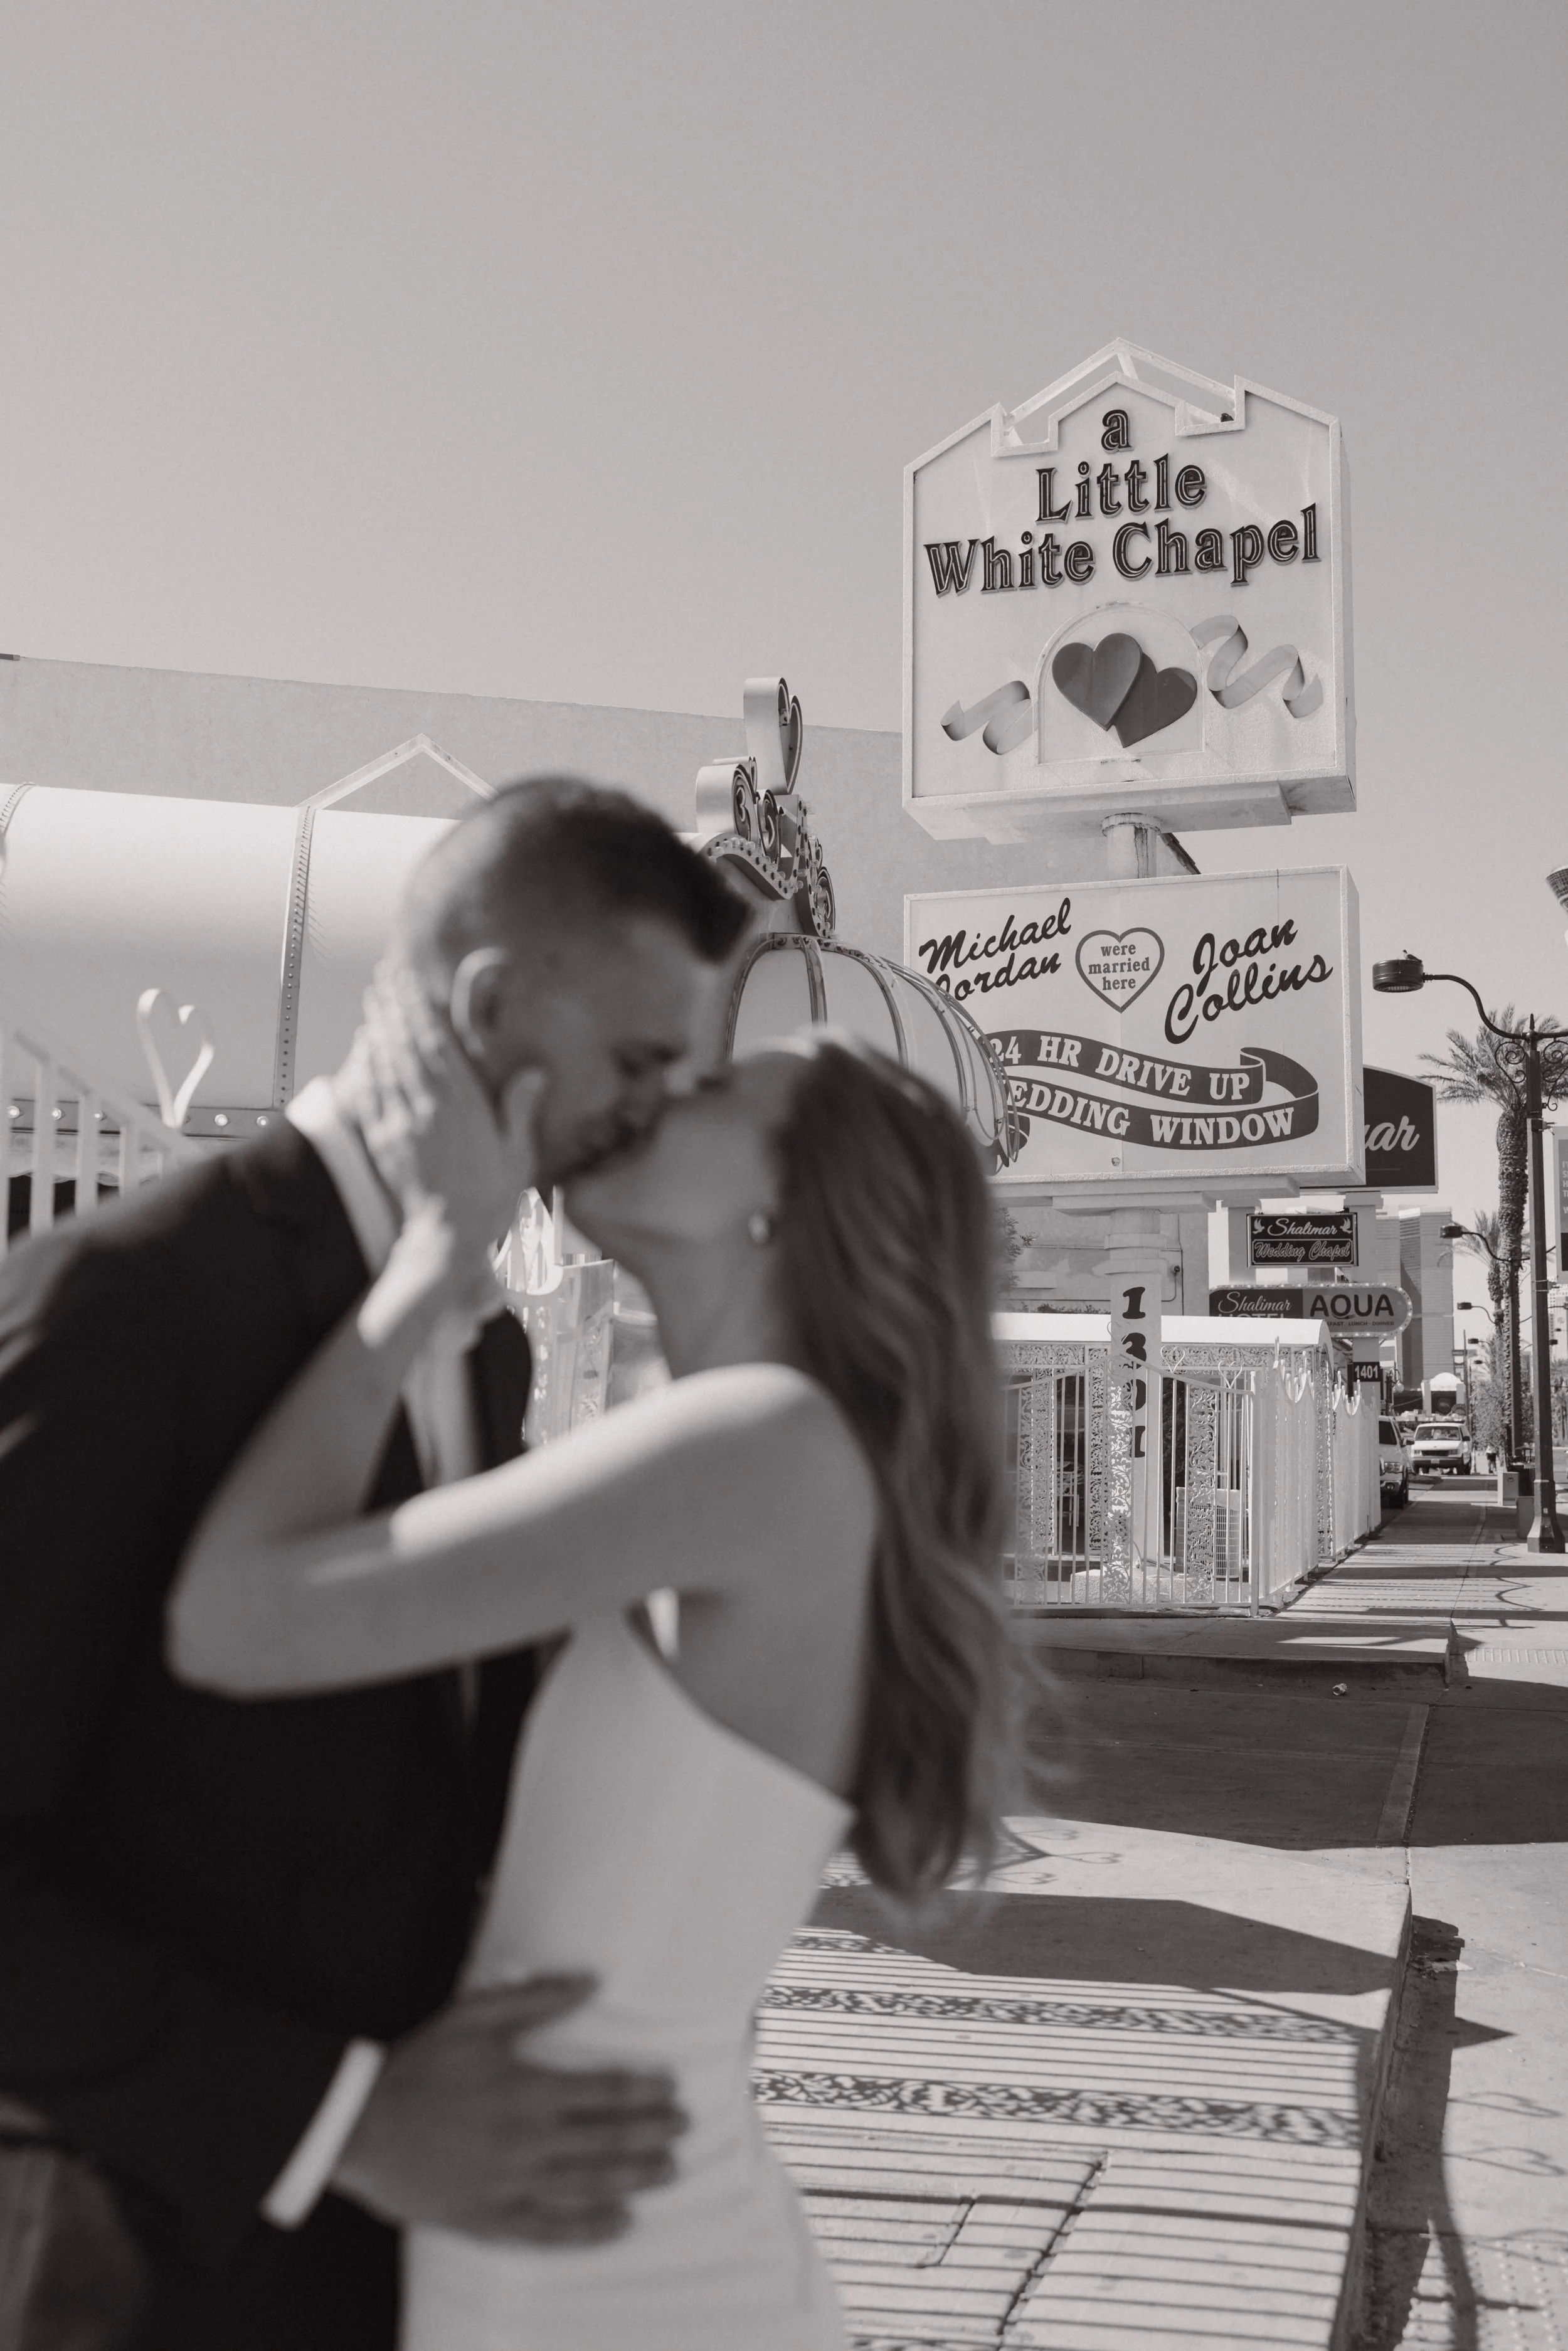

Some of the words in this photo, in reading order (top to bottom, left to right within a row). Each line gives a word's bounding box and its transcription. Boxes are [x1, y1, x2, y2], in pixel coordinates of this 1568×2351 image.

[1101, 409, 1133, 453] a
[1036, 453, 1207, 524] Little
[923, 531, 1095, 598] White
[1112, 502, 1322, 587] Chapel
[919, 898, 1071, 974] Michael
[1101, 944, 1136, 956] were
[1088, 957, 1150, 974] married
[1193, 919, 1298, 997] Joan
[1102, 976, 1136, 990] here
[1165, 954, 1333, 1044] Collins
[989, 1036, 1022, 1064] 24
[1037, 1035, 1082, 1068] HR
[1094, 1048, 1192, 1096] DRIVE
[1209, 1073, 1249, 1100] UP
[1002, 1079, 1130, 1136] EDDING
[1150, 1107, 1294, 1145] WINDOW
[1267, 1218, 1337, 1236] Shalimar
[1254, 1242, 1305, 1262] Wedding
[1309, 1240, 1350, 1261] Chapel
[1218, 1292, 1291, 1313] Shalimar
[1310, 1294, 1394, 1319] AQUA
[1355, 1365, 1378, 1379] 1401
